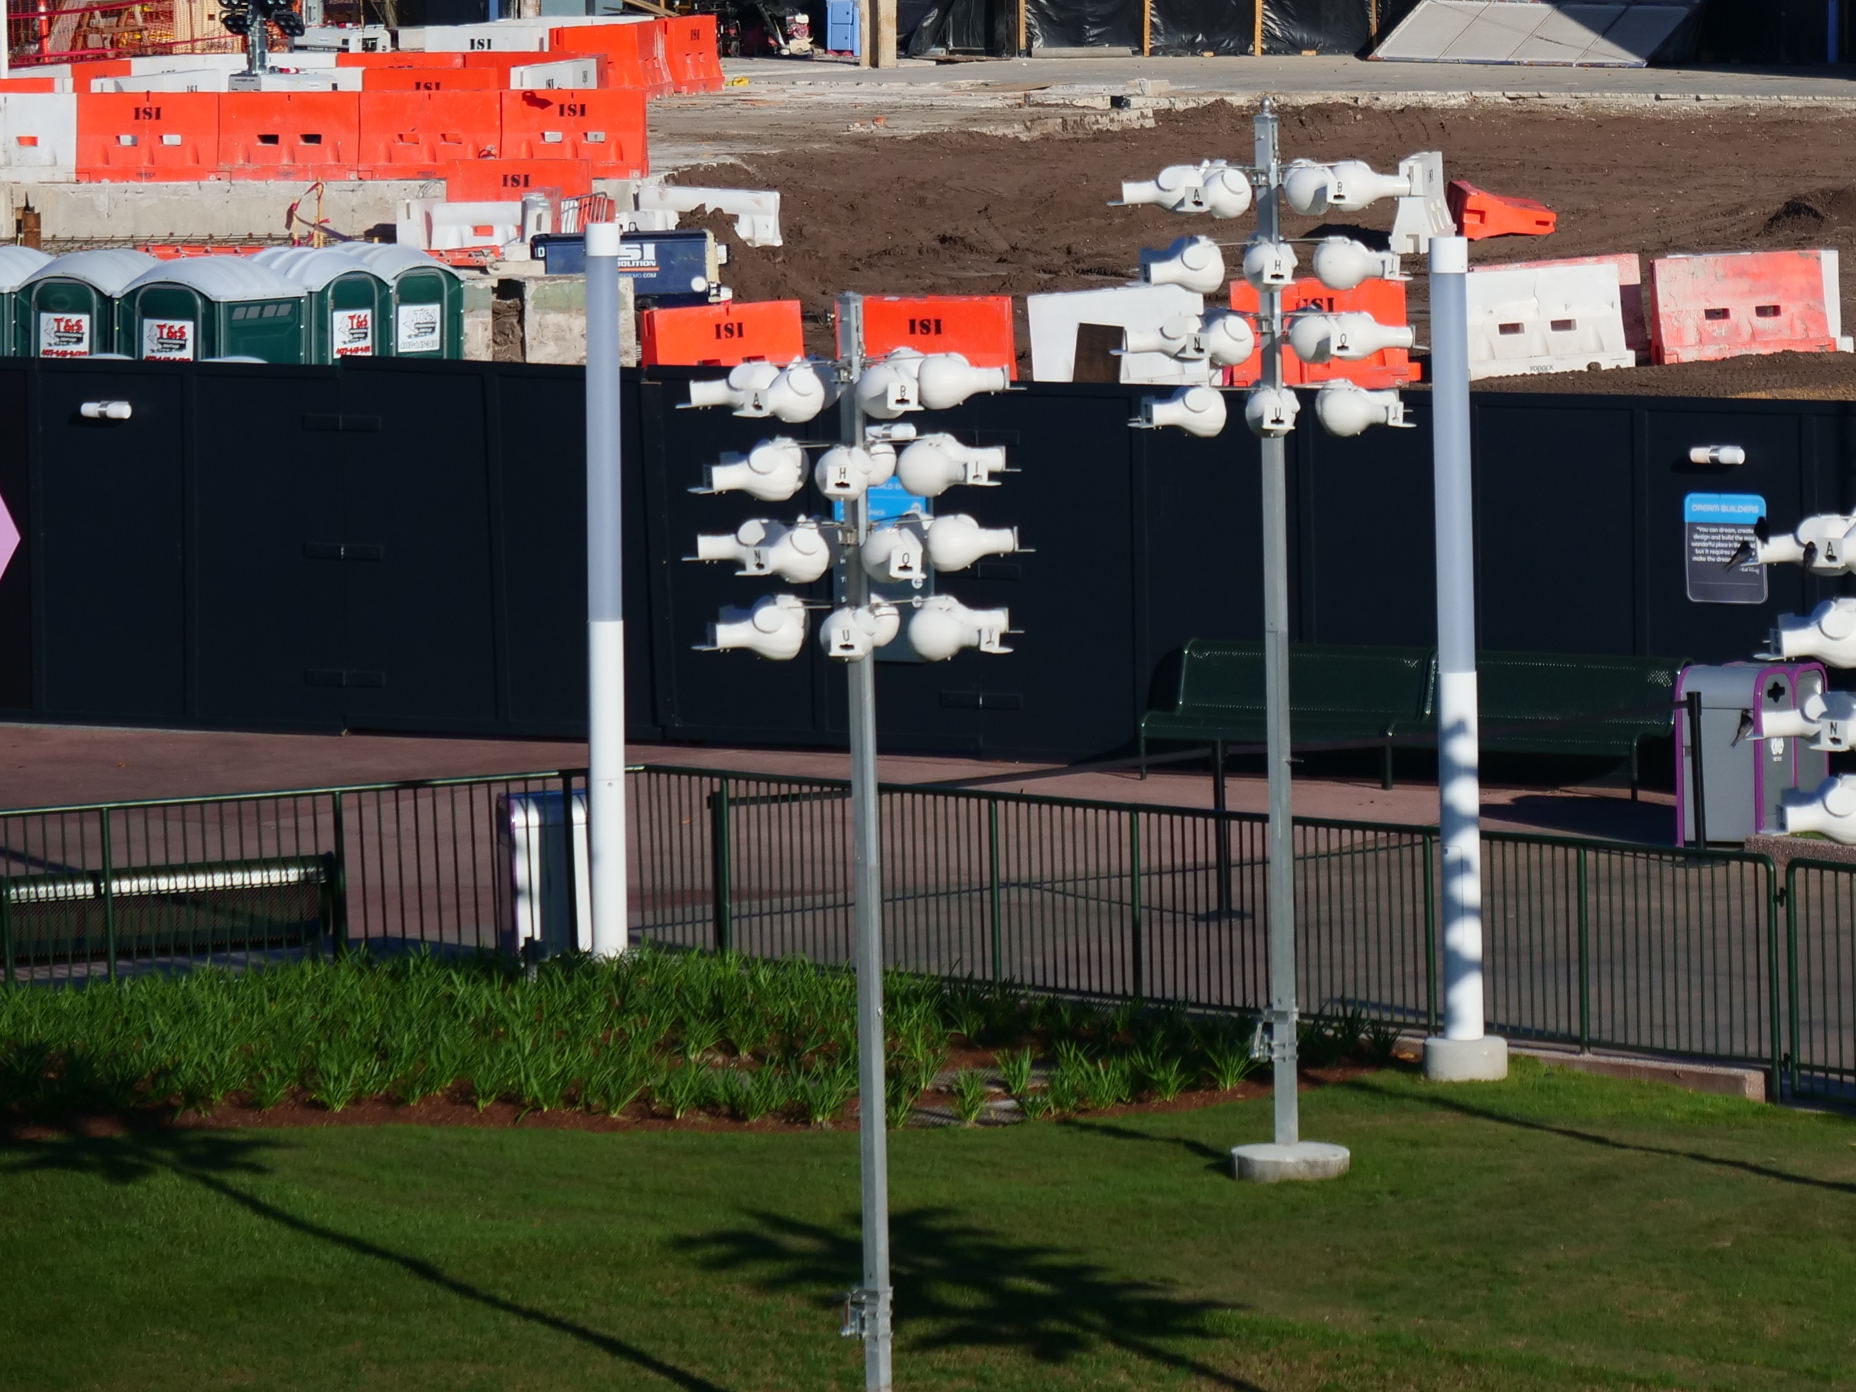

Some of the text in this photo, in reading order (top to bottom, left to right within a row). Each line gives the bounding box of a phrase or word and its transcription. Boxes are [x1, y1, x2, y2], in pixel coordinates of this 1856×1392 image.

[469, 38, 492, 50] ISI
[134, 107, 162, 120] ISI
[558, 103, 586, 117] ISI
[502, 174, 530, 188] ISI
[1336, 181, 1343, 194] B
[1193, 189, 1200, 201] A
[1274, 260, 1281, 272] H
[715, 322, 744, 340] ISI
[908, 318, 943, 335] ISI
[1193, 336, 1201, 348] N
[900, 385, 906, 398] B
[753, 393, 760, 406] A
[1274, 407, 1281, 419] U
[839, 467, 846, 479] H
[1692, 504, 1759, 514] DREAM BUILDERS
[1826, 542, 1833, 554] A
[754, 550, 761, 563] N
[842, 629, 850, 642] U
[1830, 722, 1837, 735] N
